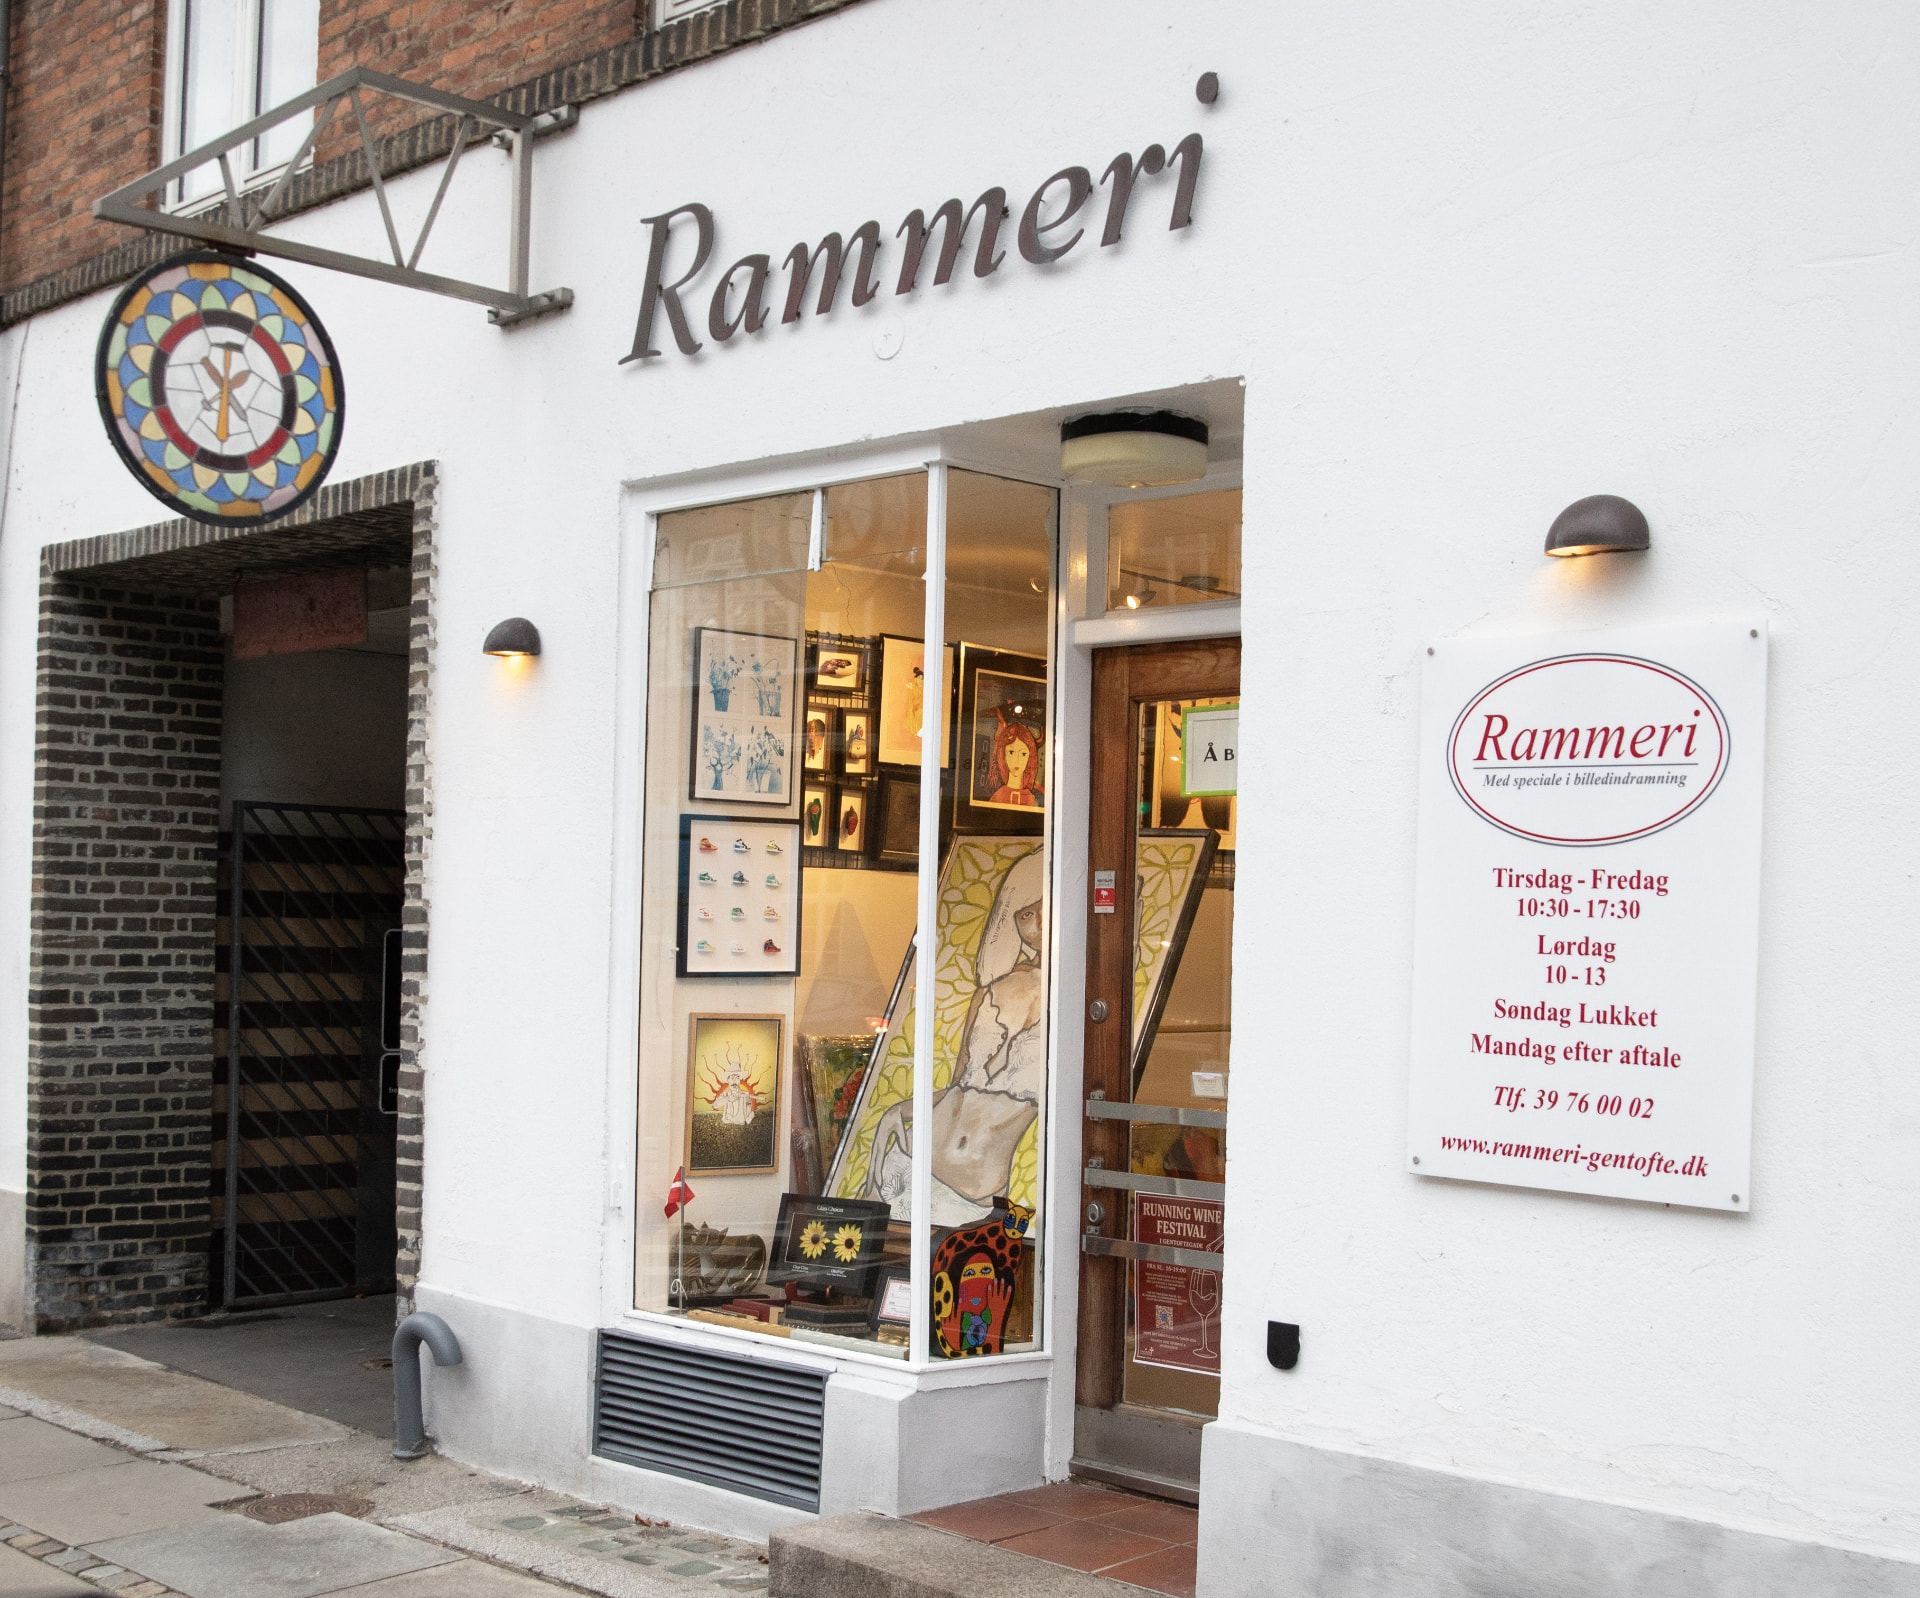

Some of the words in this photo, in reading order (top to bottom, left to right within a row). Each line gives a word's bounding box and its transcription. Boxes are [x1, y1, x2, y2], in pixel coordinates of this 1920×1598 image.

[618, 71, 1220, 366] Rammeri
[1472, 708, 1702, 762] Rammeri
[1482, 772, 1511, 787] Med
[1513, 772, 1562, 790] speciale
[1565, 772, 1571, 787] i
[1573, 771, 1688, 788] billedindramning
[1492, 867, 1573, 894] Tirsdag
[1591, 868, 1669, 897] Fredag
[1517, 897, 1569, 918] 10:30
[1587, 899, 1641, 920] 17:30
[1537, 934, 1616, 963] Lørdag
[1546, 965, 1567, 985] 10
[1585, 966, 1606, 987] 13
[1494, 998, 1572, 1028] Søndag
[1579, 1002, 1658, 1028] Lukket
[1470, 1032, 1556, 1065] Mandag
[1562, 1039, 1613, 1064] efter
[1619, 1044, 1682, 1069] aftale
[1494, 1085, 1526, 1113] Tlf.
[1533, 1088, 1559, 1110] 39
[1567, 1091, 1590, 1113] 76
[1597, 1094, 1622, 1116] 00
[1628, 1097, 1655, 1119] 02
[1440, 1136, 1709, 1177] www.rammeri-gentofte.dk
[1143, 1202, 1191, 1221] RUNNING
[1193, 1209, 1222, 1224] WINE
[1156, 1220, 1207, 1239] FESTIVAL
